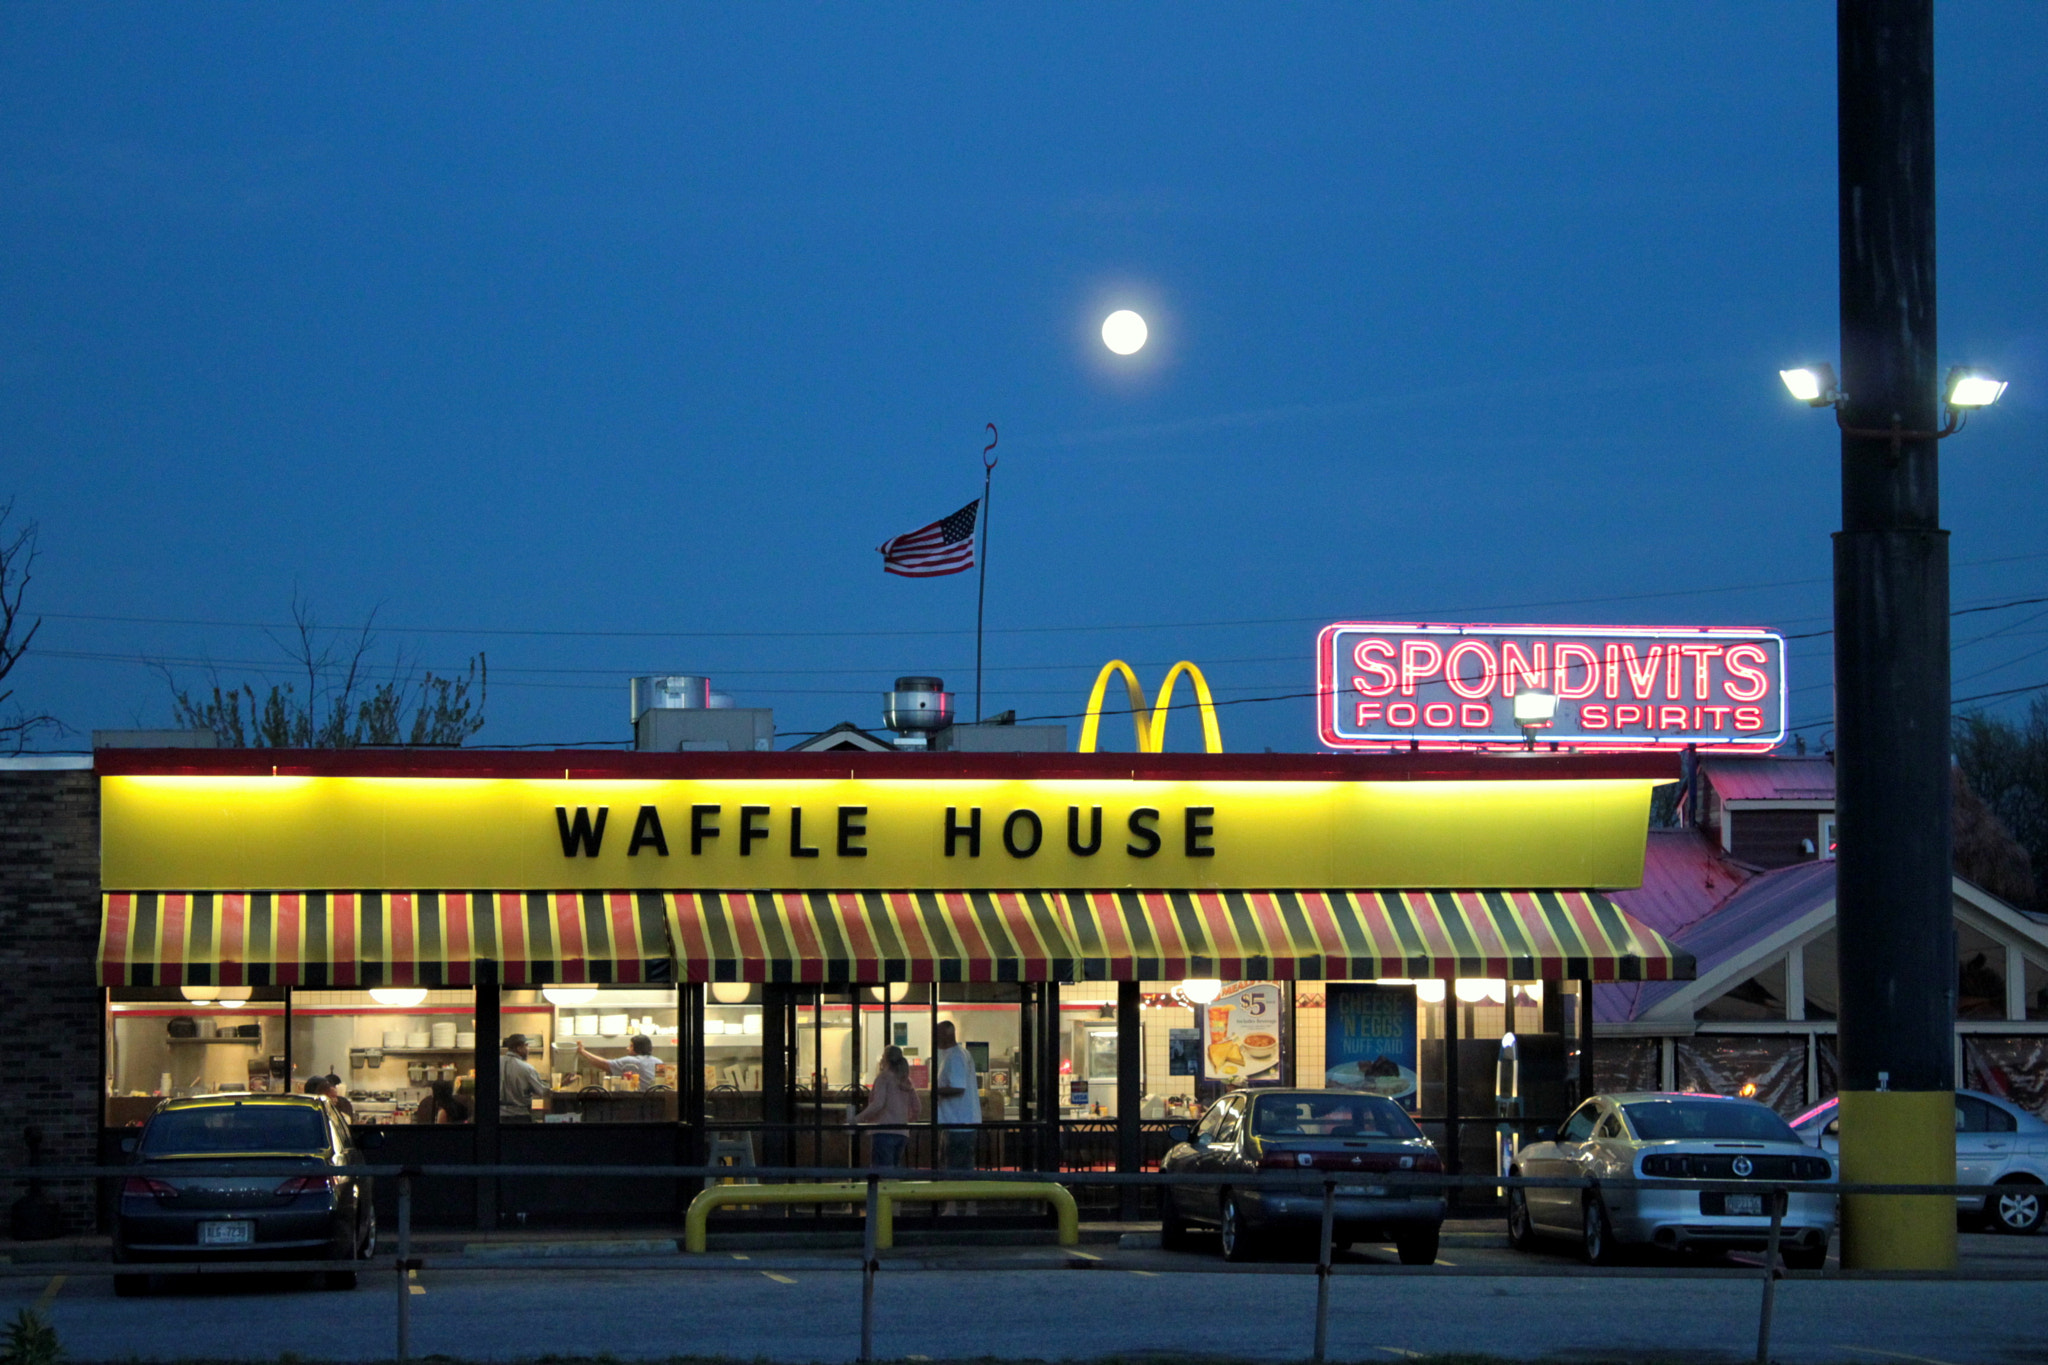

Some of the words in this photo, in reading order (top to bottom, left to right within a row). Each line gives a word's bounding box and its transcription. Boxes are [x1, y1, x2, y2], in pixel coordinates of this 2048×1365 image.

[1351, 638, 1769, 701] SPONDIVITS
[1355, 701, 1493, 728] FOOD
[1580, 703, 1765, 731] SPIRITS
[555, 805, 868, 858] WAFFLE
[943, 806, 1215, 859] HOUSE
[1240, 992, 1266, 1016] $5
[1338, 992, 1403, 1015] CHEESE
[1360, 1015, 1403, 1038] EGGS
[1375, 1038, 1403, 1055] SAID
